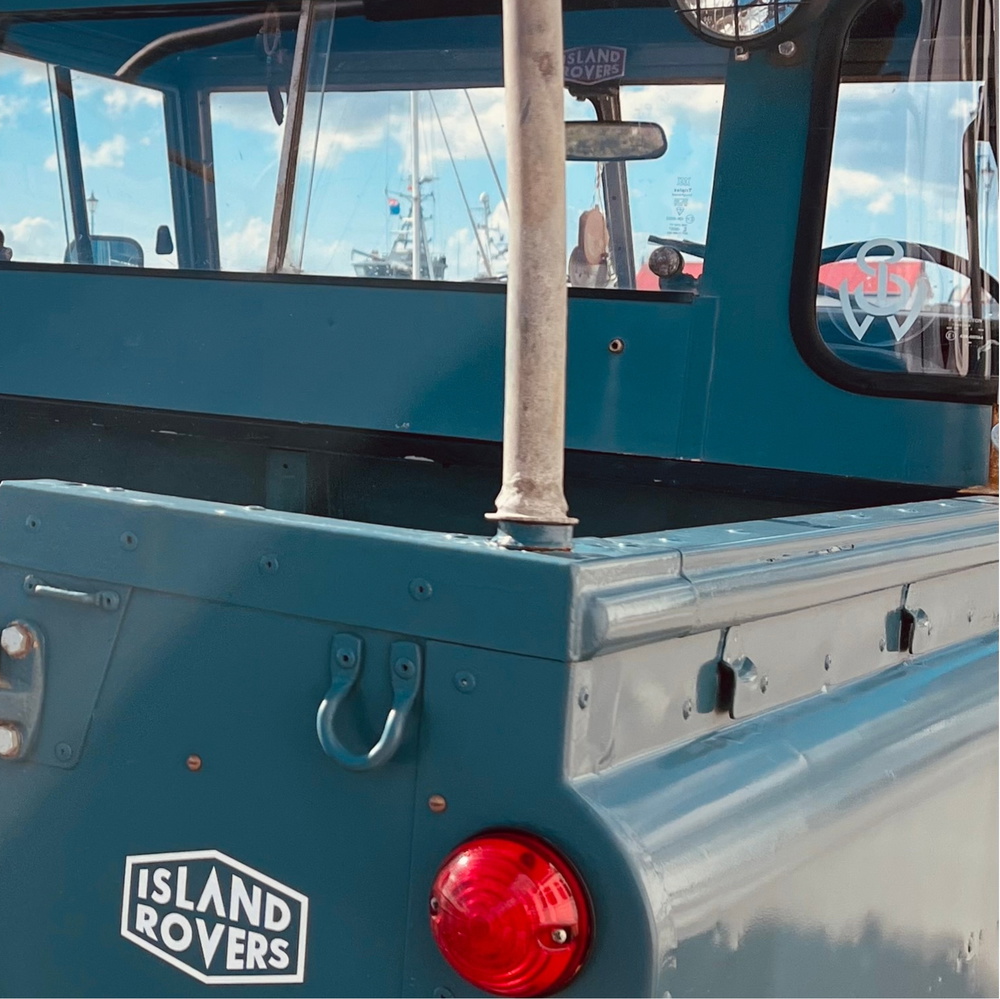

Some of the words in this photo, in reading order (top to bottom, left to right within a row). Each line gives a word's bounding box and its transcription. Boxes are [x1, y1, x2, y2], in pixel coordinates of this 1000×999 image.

[564, 48, 621, 65] SLAND
[137, 865, 292, 932] ISLAND
[135, 903, 290, 970] ROVERS
